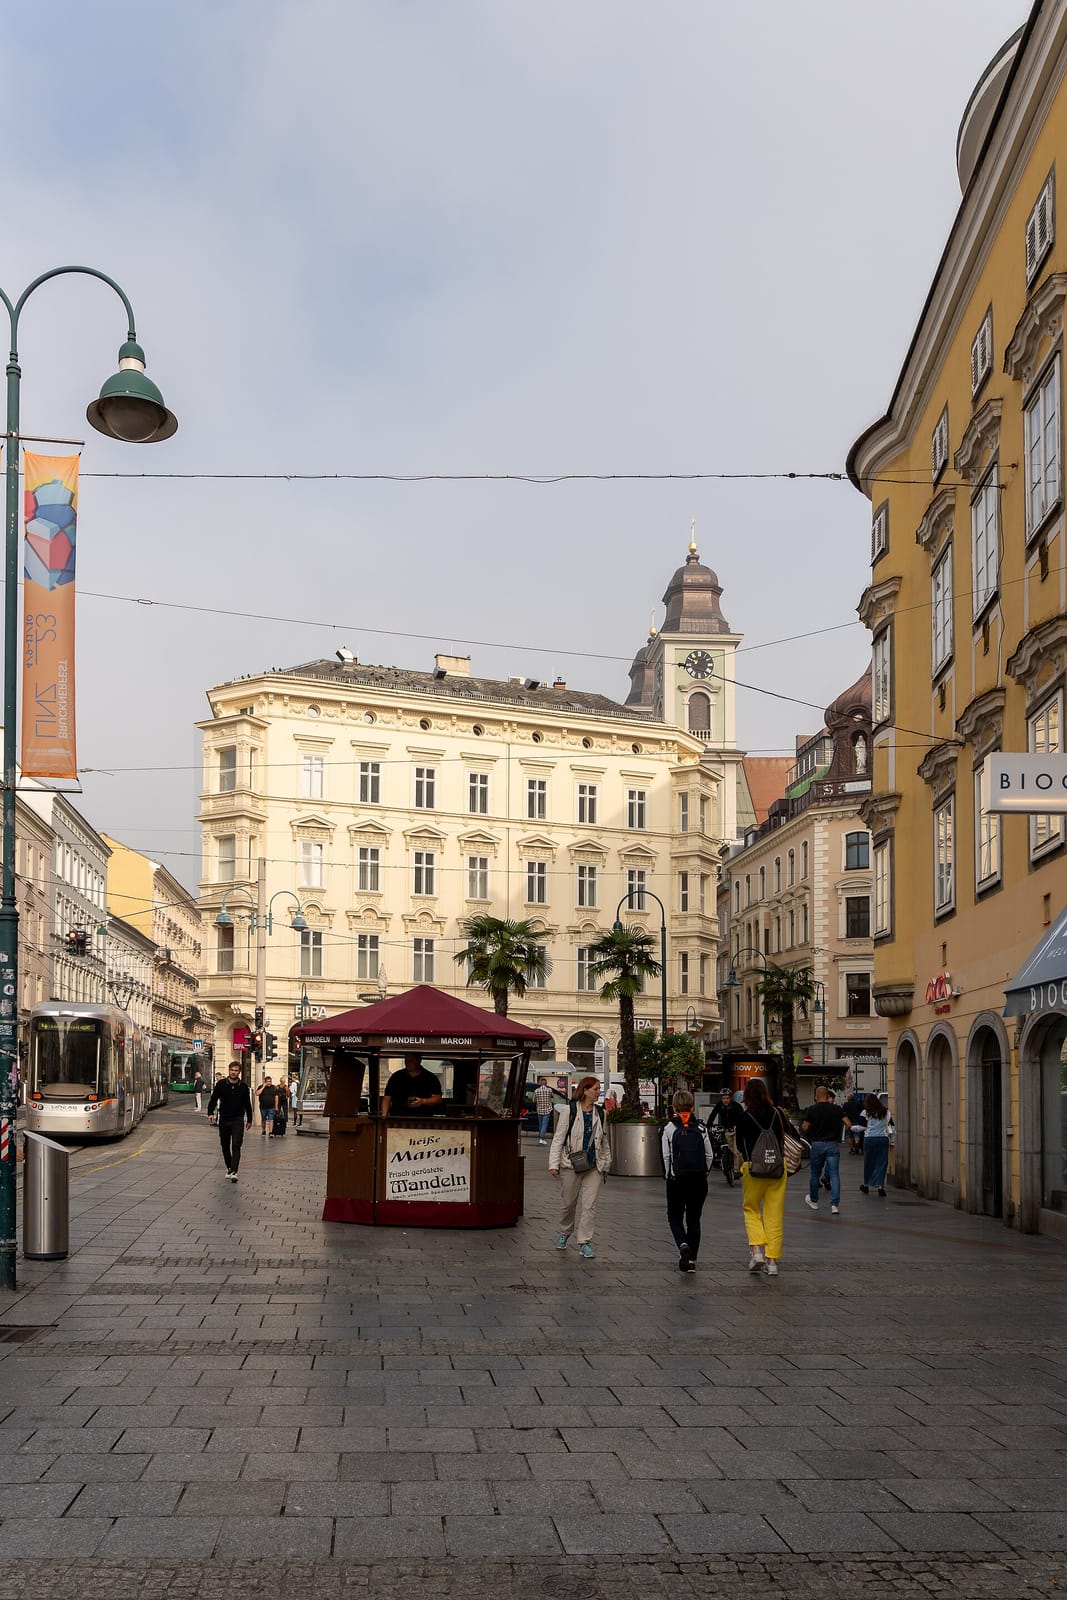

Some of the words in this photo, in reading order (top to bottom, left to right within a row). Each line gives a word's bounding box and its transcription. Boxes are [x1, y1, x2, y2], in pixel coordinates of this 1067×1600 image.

[633, 1019, 652, 1031] IPA
[386, 1036, 425, 1044] MANDELN
[440, 1037, 472, 1045] MARONI
[409, 1135, 441, 1147] heiße
[391, 1143, 465, 1163] Maroni
[390, 1174, 467, 1193] Mandeln
